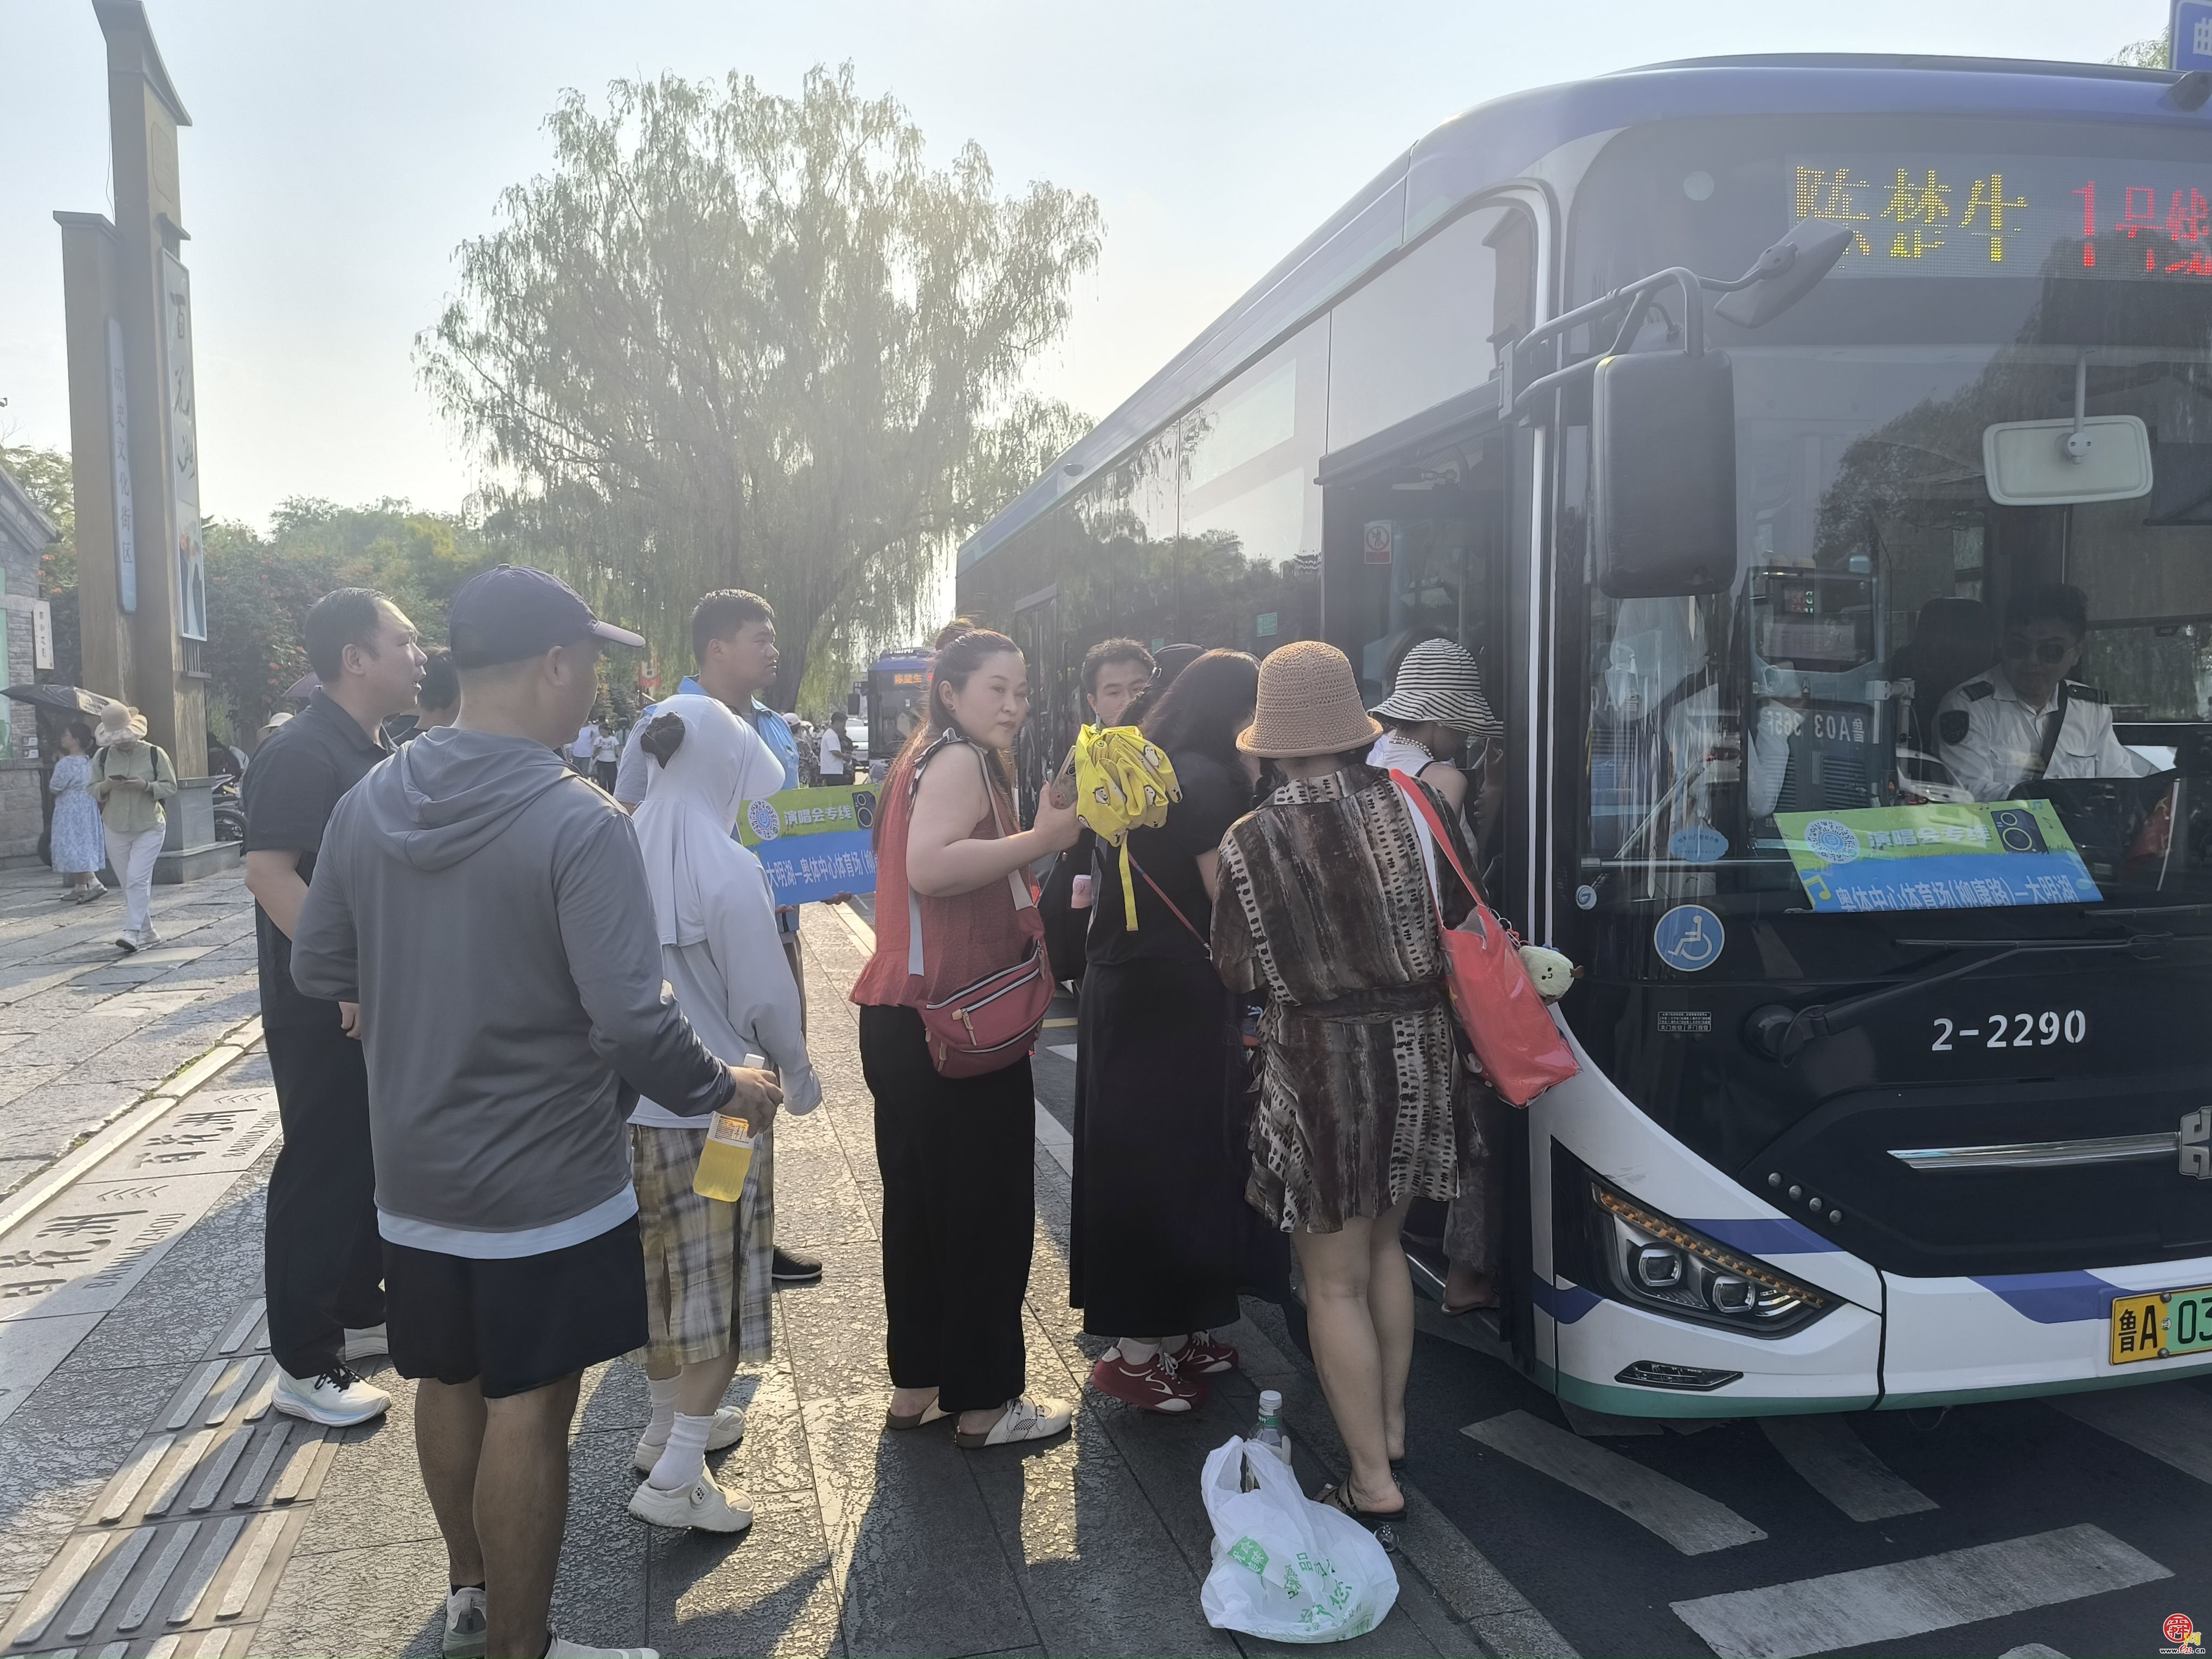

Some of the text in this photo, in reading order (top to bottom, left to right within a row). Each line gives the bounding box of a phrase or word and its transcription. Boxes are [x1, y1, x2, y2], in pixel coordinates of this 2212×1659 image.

[114, 367, 133, 564] 历史文化街区
[783, 805, 852, 825] 演唱会专线
[1867, 824, 1993, 848] 演唱会专线
[1932, 1009, 2086, 1051] 2-2290
